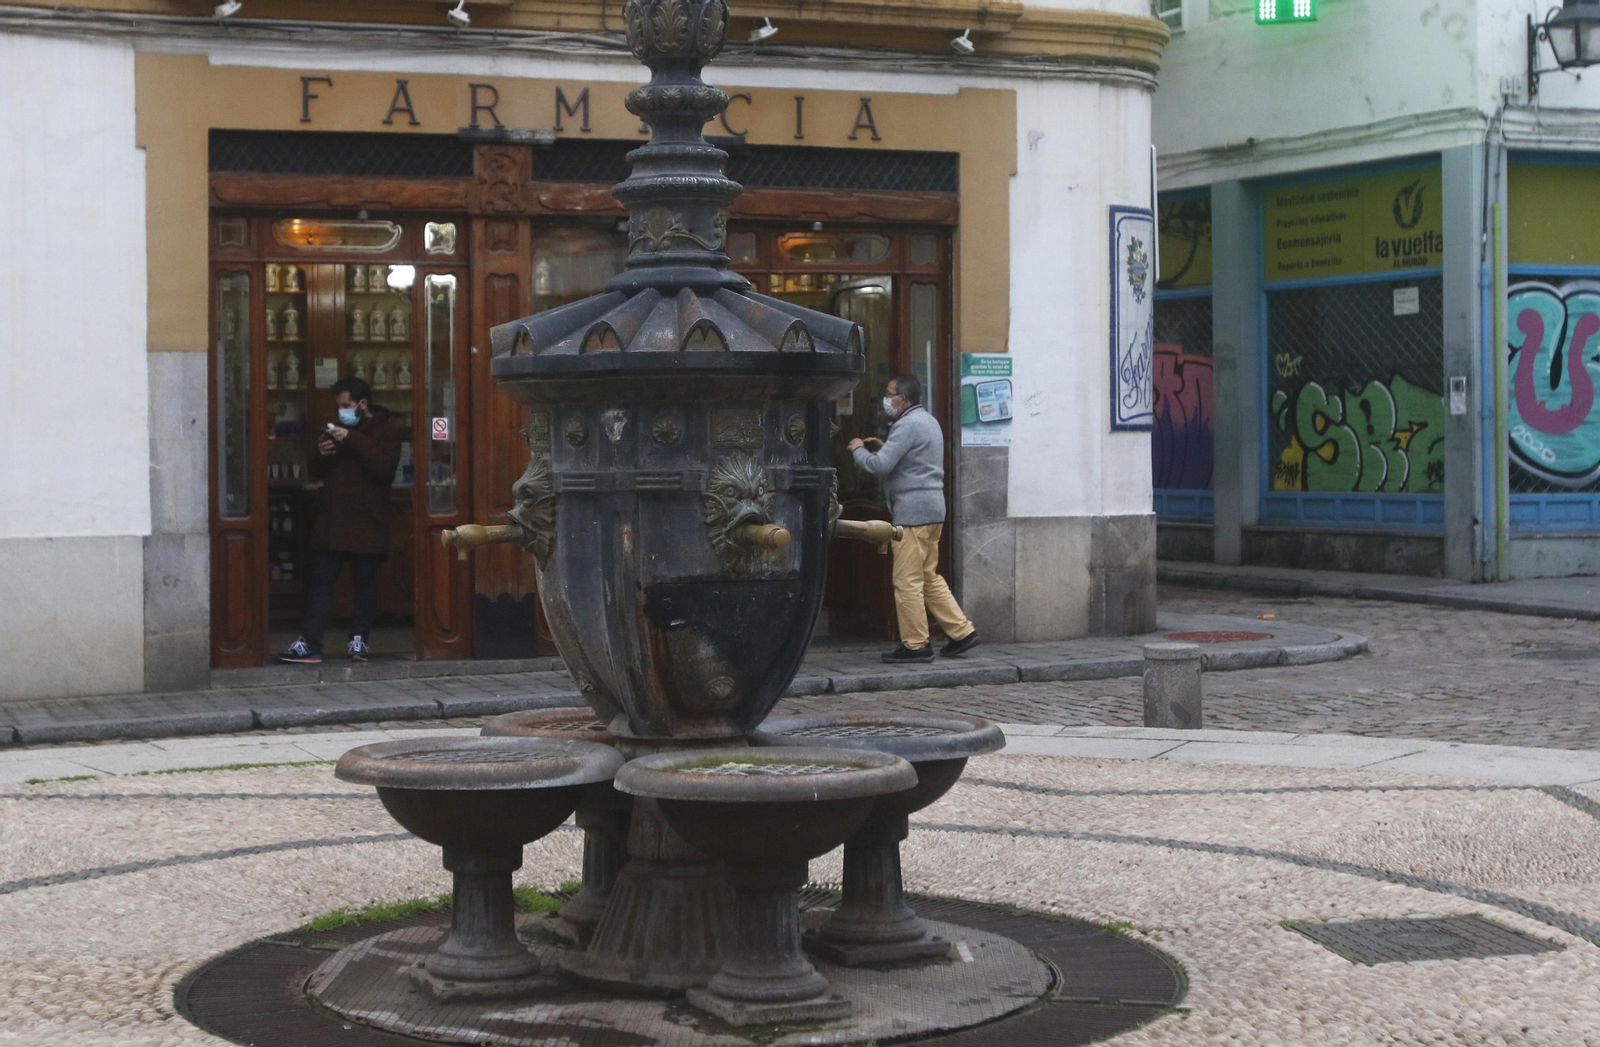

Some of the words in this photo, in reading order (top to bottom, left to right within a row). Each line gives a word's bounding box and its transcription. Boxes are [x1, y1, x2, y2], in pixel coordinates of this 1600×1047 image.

[299, 76, 882, 141] FARMCIA
[1317, 186, 1360, 202] sostenible
[1276, 217, 1309, 229] Proyectos
[1310, 212, 1347, 225] educativos
[1375, 236, 1389, 259] la
[1391, 229, 1443, 257] vuelta
[1311, 256, 1343, 268] Domicilio
[1393, 259, 1401, 268] AL
[1402, 256, 1428, 267] MUNDO
[1510, 425, 1556, 464] 2020
